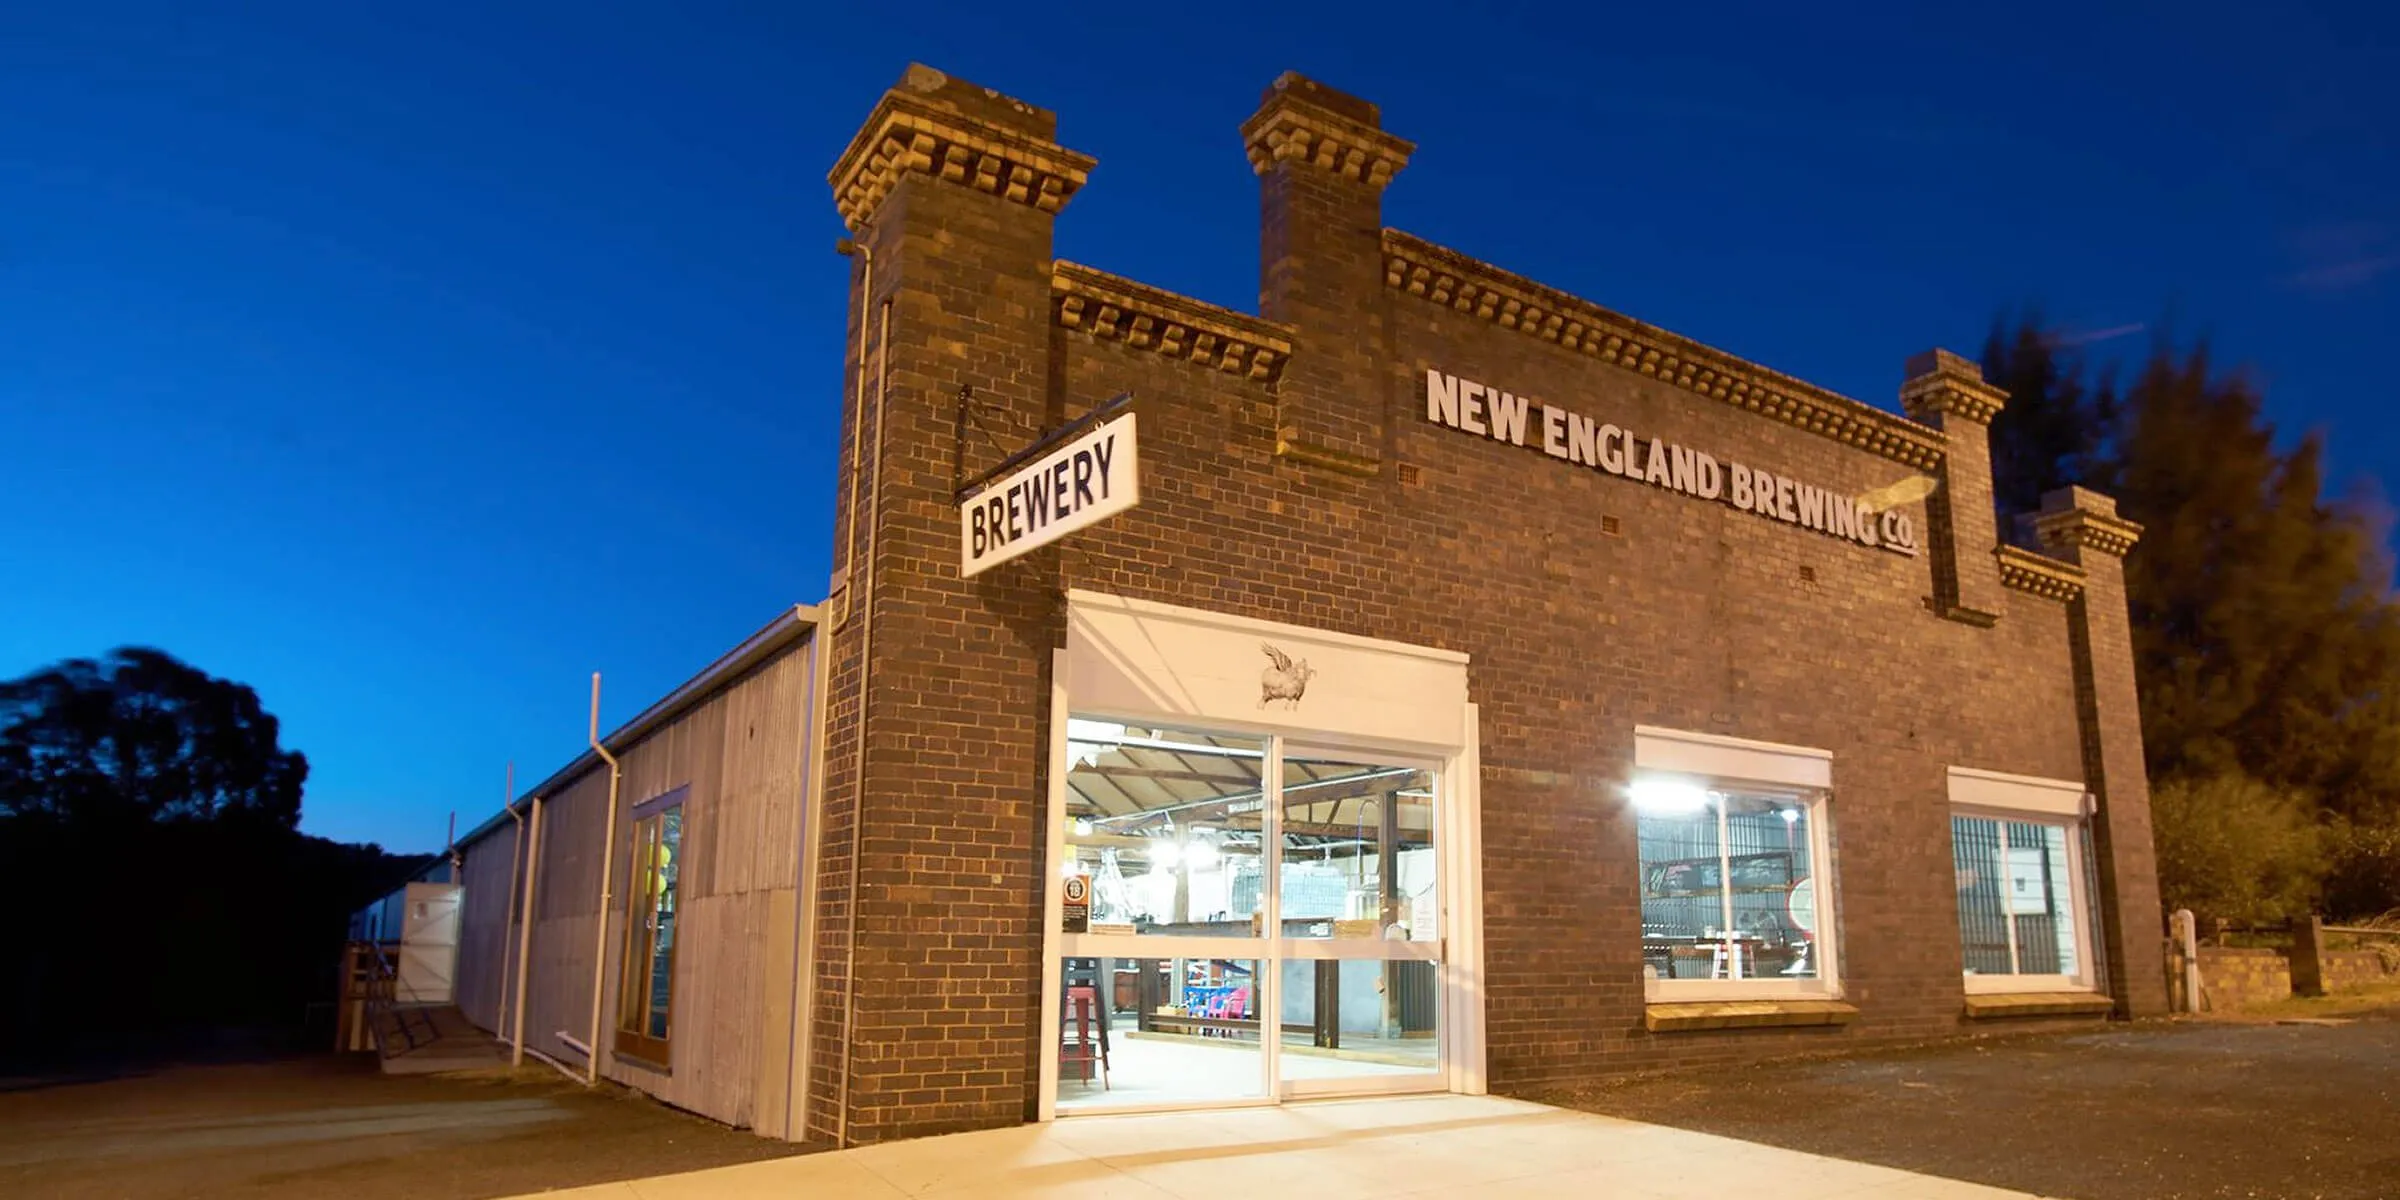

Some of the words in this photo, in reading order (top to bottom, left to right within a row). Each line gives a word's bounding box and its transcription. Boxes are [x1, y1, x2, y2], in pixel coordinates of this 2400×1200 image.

[971, 434, 1116, 560] BREWERY
[1426, 369, 1529, 447] NEW
[1543, 405, 1721, 500] ENGLAND
[1731, 461, 1878, 546] BREWING
